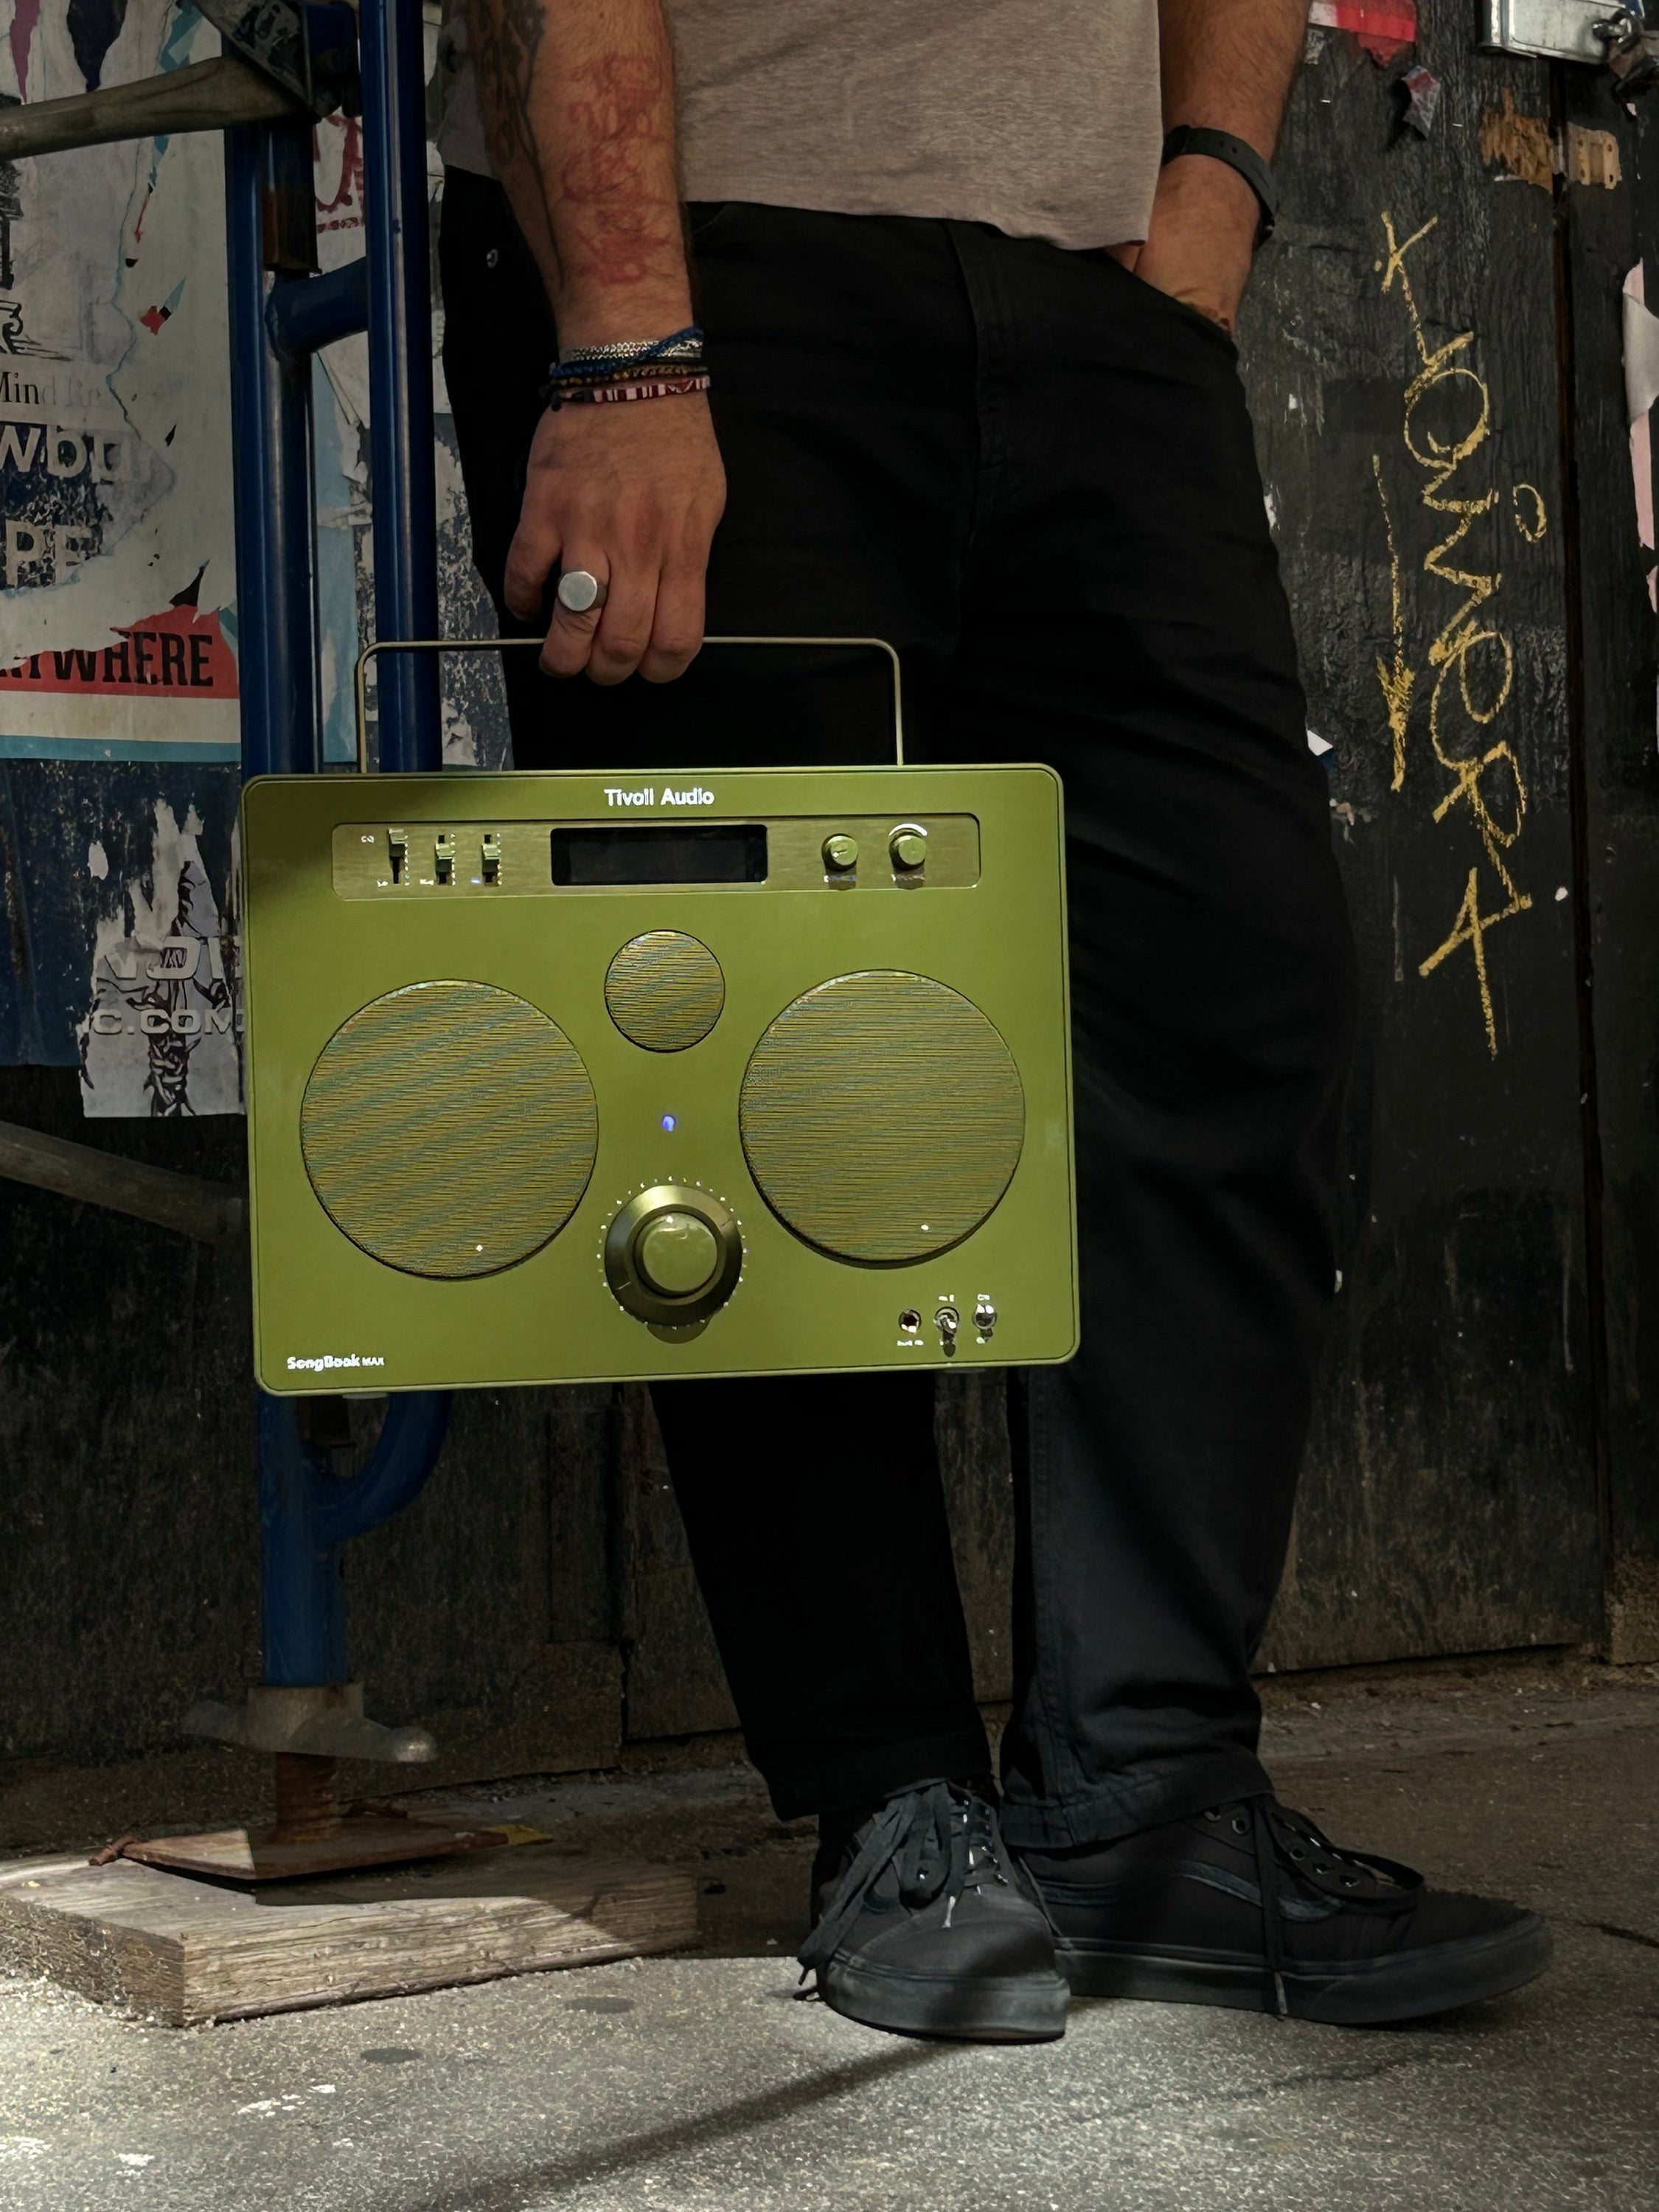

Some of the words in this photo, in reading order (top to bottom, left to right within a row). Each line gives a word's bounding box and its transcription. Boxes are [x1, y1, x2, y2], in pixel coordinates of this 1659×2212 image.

[603, 787, 655, 807] Tivoli
[660, 787, 715, 806] Audio
[286, 1353, 361, 1372] SongBook
